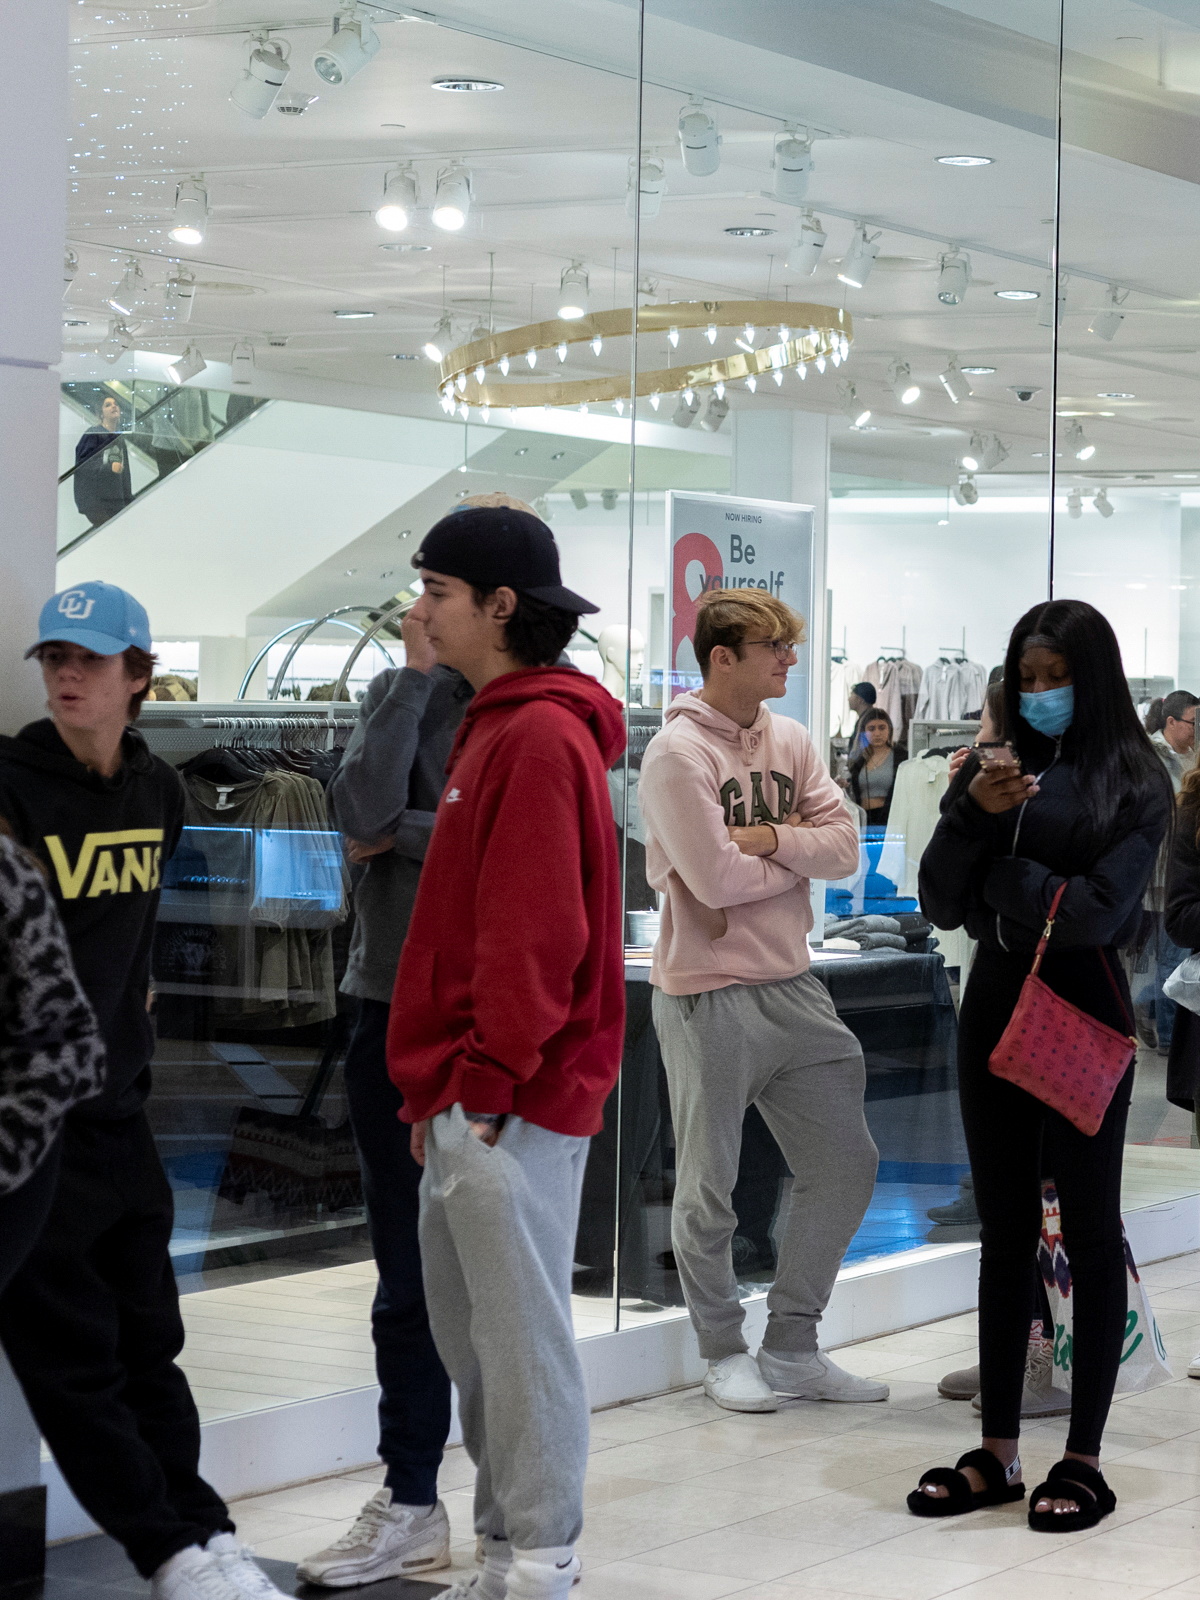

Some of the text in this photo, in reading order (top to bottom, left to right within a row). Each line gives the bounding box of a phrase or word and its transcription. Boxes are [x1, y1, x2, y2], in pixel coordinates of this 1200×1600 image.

[725, 512, 763, 524] NOW HIRING
[730, 534, 756, 564] Be
[719, 770, 795, 827] GAP
[43, 829, 164, 899] VANS
